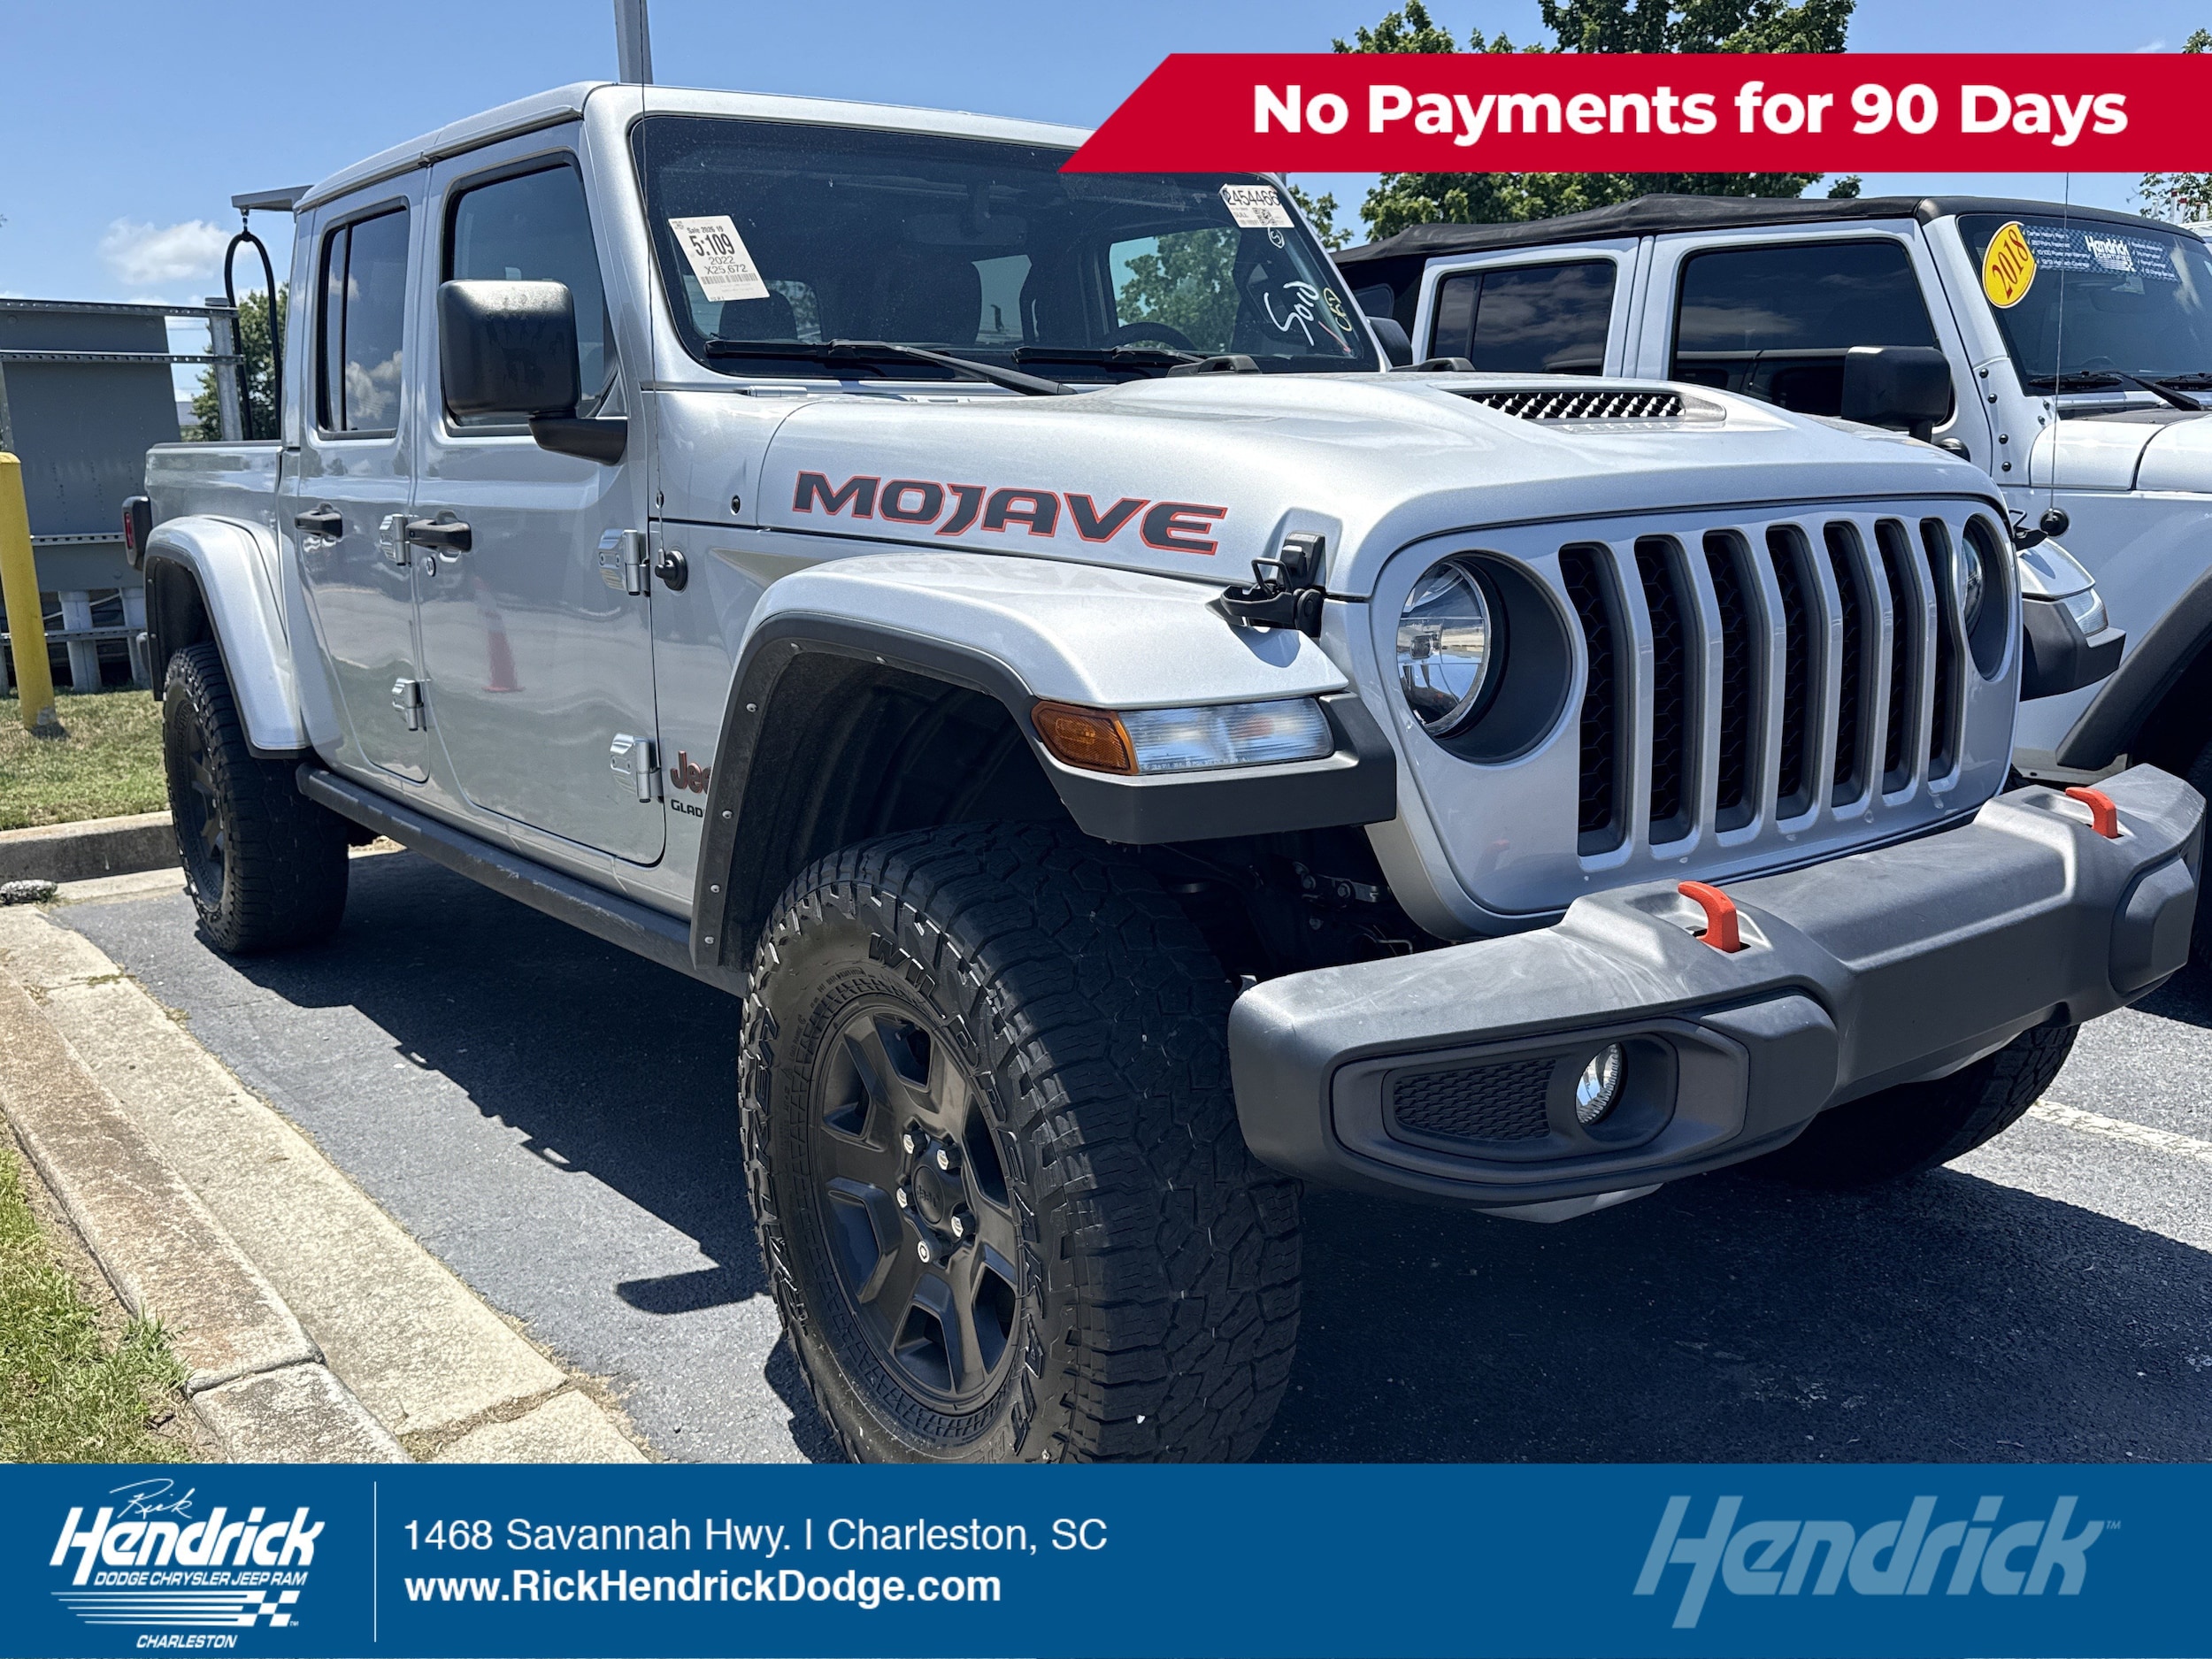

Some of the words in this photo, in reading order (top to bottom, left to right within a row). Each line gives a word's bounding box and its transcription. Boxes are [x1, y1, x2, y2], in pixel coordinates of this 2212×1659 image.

[1223, 188, 1280, 206] 2454466
[689, 234, 735, 257] 5:109
[2084, 234, 2131, 258] Hendrick
[704, 264, 748, 274] X25,672
[709, 256, 735, 265] 2022
[1992, 228, 2029, 299] 2018
[792, 471, 1228, 556] MOJAVE
[671, 799, 703, 818] GLAD
